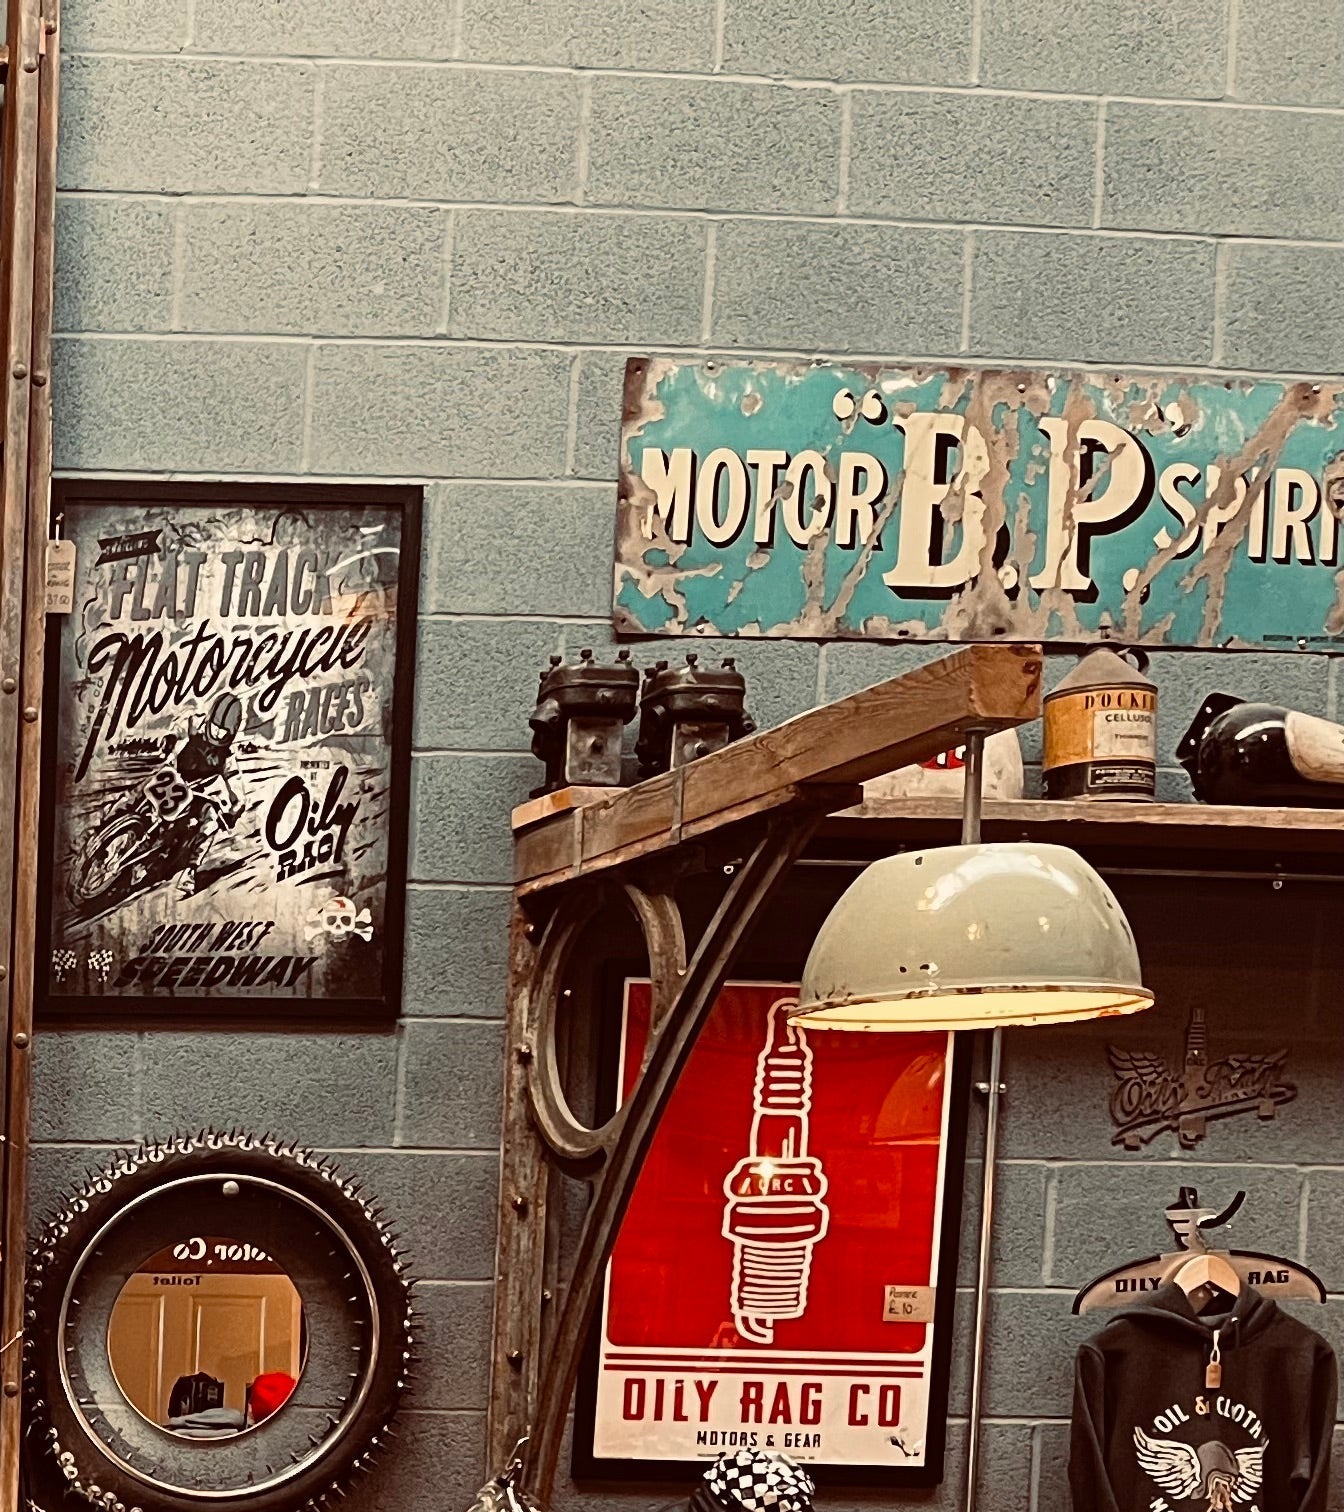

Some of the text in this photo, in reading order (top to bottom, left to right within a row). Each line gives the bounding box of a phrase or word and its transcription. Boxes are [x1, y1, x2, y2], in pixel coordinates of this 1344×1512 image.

[641, 447, 888, 550] MOTOR
[110, 550, 340, 621] FLAT TRACK
[74, 618, 373, 782] Motorcycle
[276, 678, 370, 743] RACES
[265, 766, 360, 864] Oily
[276, 833, 336, 883] RAG
[140, 920, 275, 954] SOUTH WEST
[114, 956, 318, 988] SPEEDWAY
[1115, 1270, 1290, 1293] OILY RAG
[623, 1378, 901, 1428] OILY RAG CO
[1152, 1404, 1189, 1434] OIL
[1216, 1396, 1263, 1440] CLOTH
[697, 1430, 822, 1449] MOTORS & GEAR
